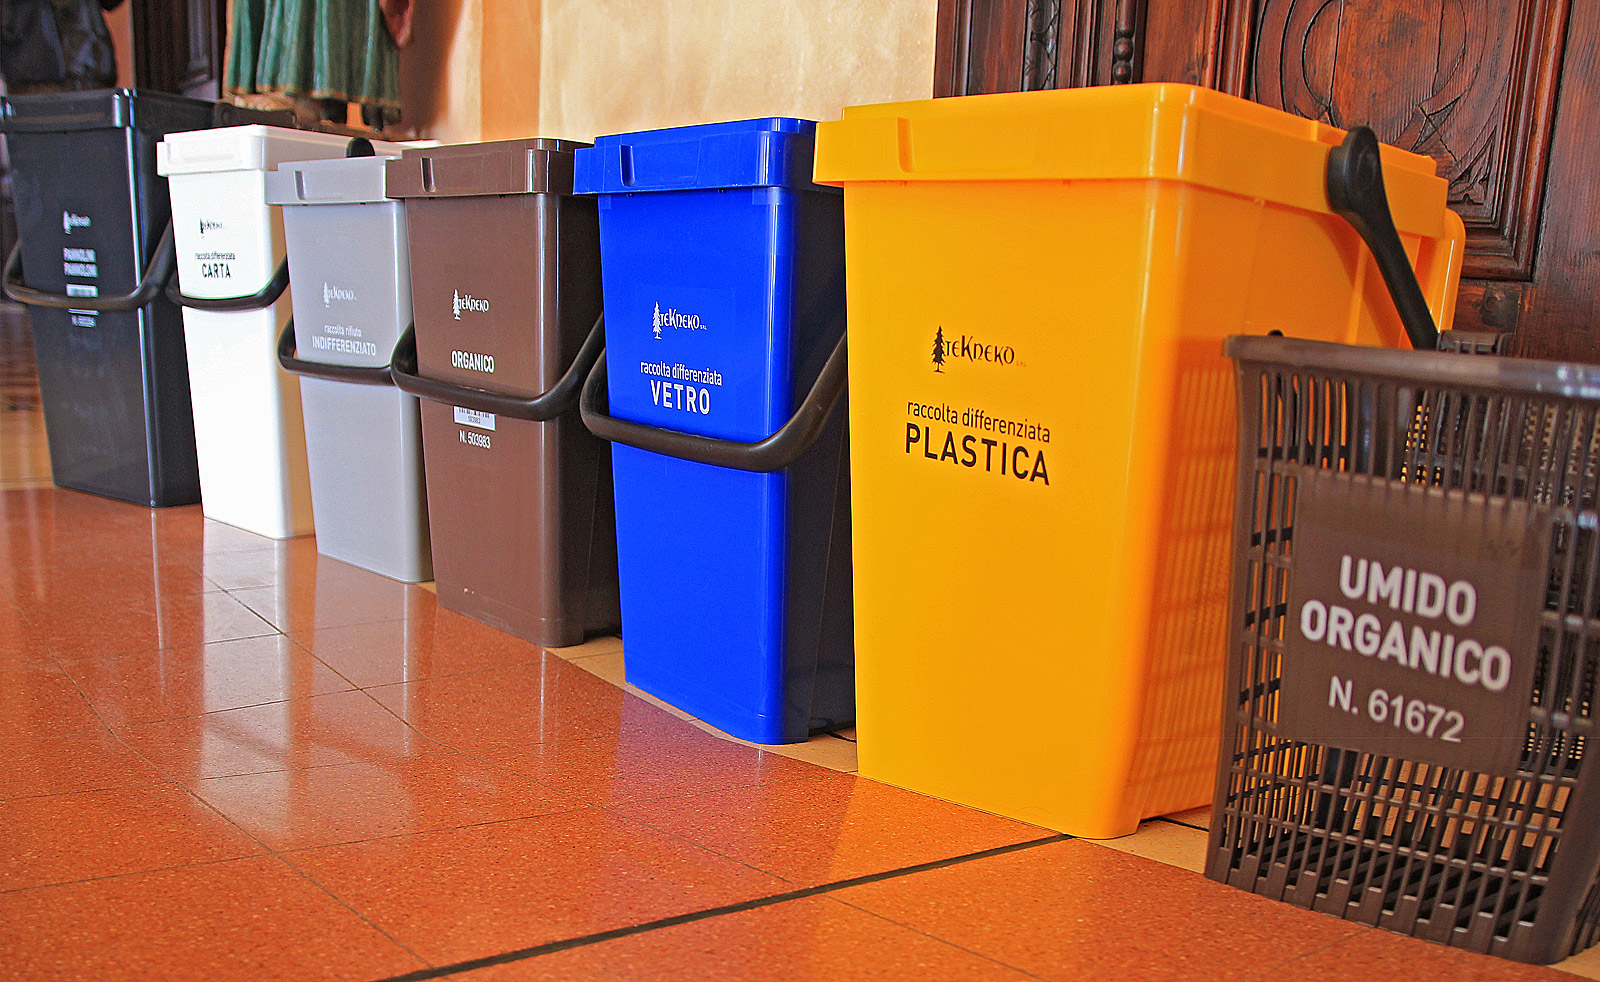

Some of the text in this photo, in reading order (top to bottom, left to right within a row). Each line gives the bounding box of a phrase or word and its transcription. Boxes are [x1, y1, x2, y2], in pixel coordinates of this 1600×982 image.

[202, 262, 231, 278] CARTA
[324, 324, 345, 336] raccolta
[312, 335, 376, 356] INDIFFERENZIATO
[451, 350, 495, 374] ORGANICO
[640, 361, 723, 386] raccolta differenziata
[650, 379, 711, 415] VETRO
[459, 429, 467, 444] N.
[907, 402, 1051, 443] raccolta differenziata
[905, 422, 1050, 486] PLASTICA
[1339, 554, 1477, 626] UMIDO
[1300, 599, 1512, 692] ORGANICO
[1328, 675, 1465, 743] N. 61672
